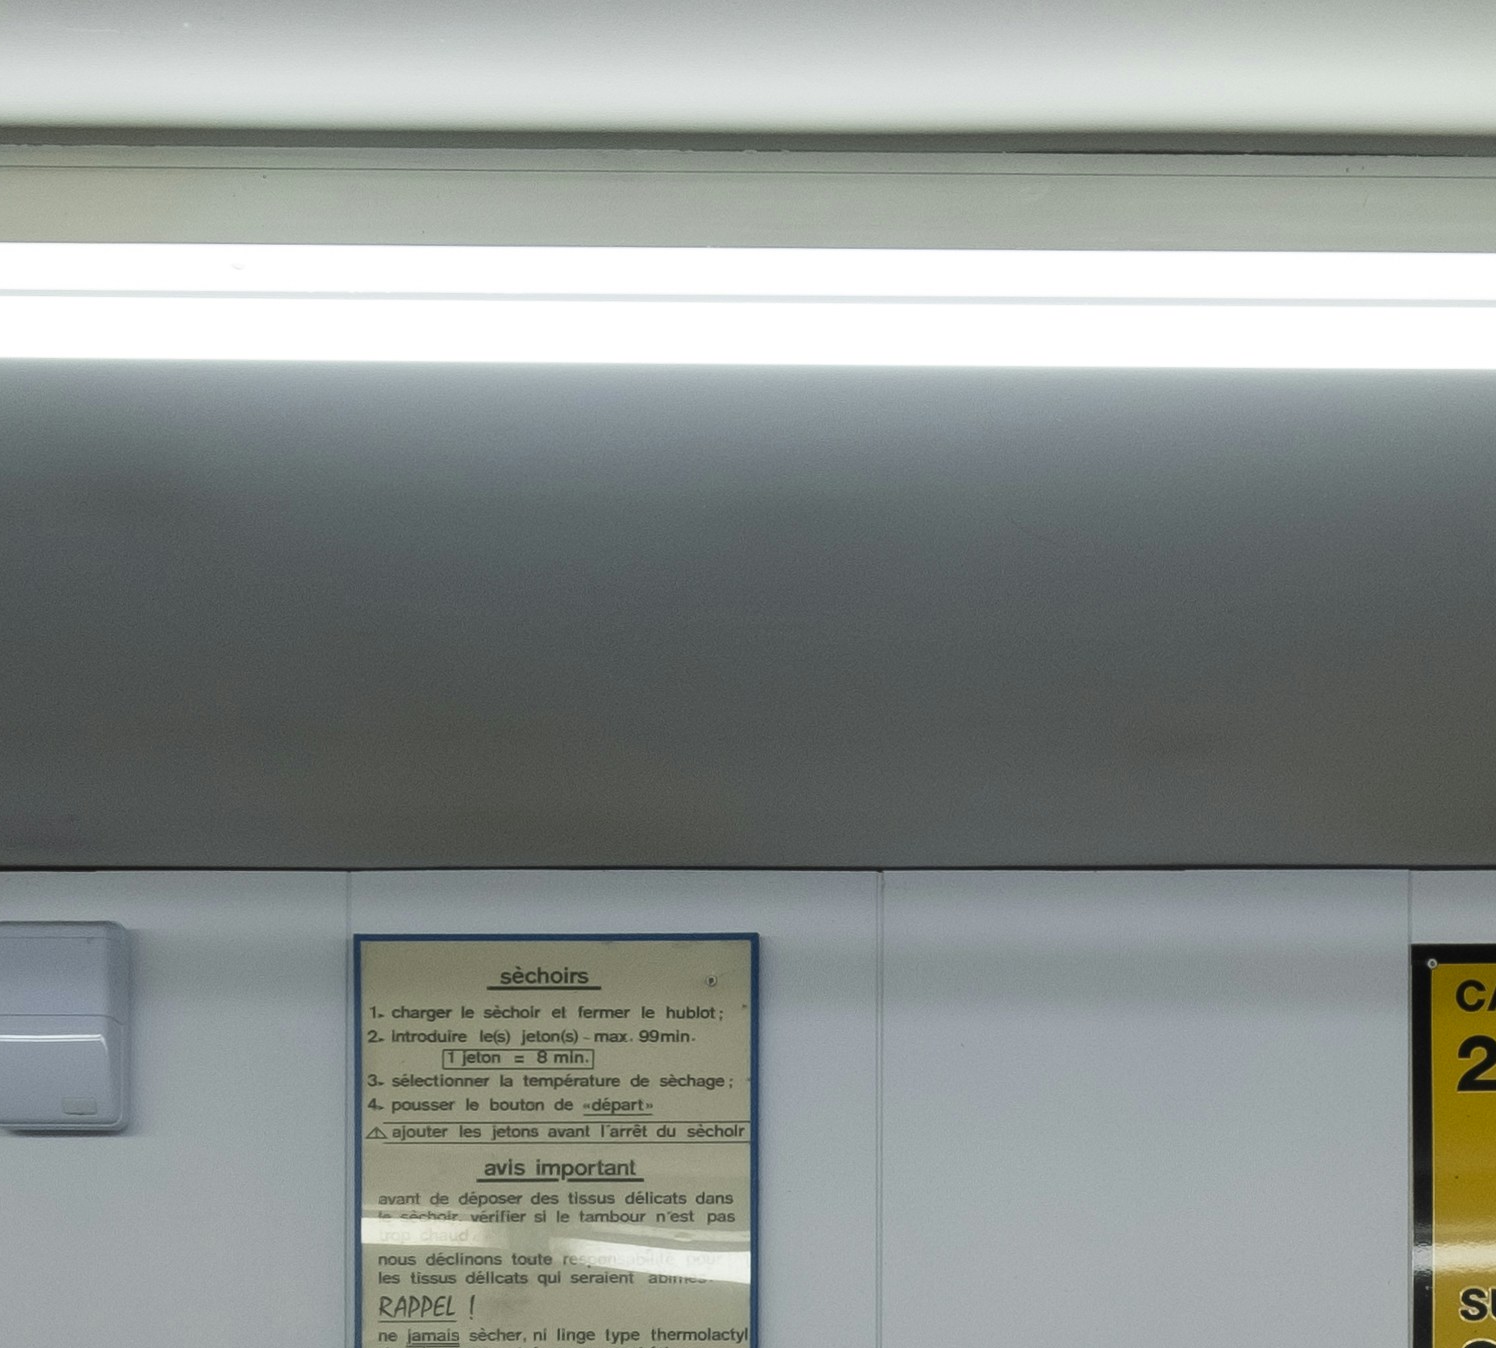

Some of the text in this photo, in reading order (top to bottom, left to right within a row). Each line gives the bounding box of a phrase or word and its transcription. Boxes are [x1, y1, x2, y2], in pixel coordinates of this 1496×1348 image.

[392, 1006, 451, 1021] charger
[461, 1006, 474, 1019] le
[552, 1007, 567, 1019] et
[578, 1006, 630, 1019] fermer
[641, 1006, 655, 1019] le
[392, 1074, 489, 1088] sélectionner
[500, 1074, 513, 1088] la
[523, 1074, 620, 1091] température
[630, 1074, 649, 1088] de
[392, 1099, 454, 1115] pousser
[466, 1098, 479, 1112] le
[489, 1098, 545, 1112] bouton
[554, 1098, 573, 1112] de
[484, 1159, 636, 1178] avis important
[378, 1251, 552, 1266] nous déclinons toute
[378, 1295, 456, 1318] RAPPEL
